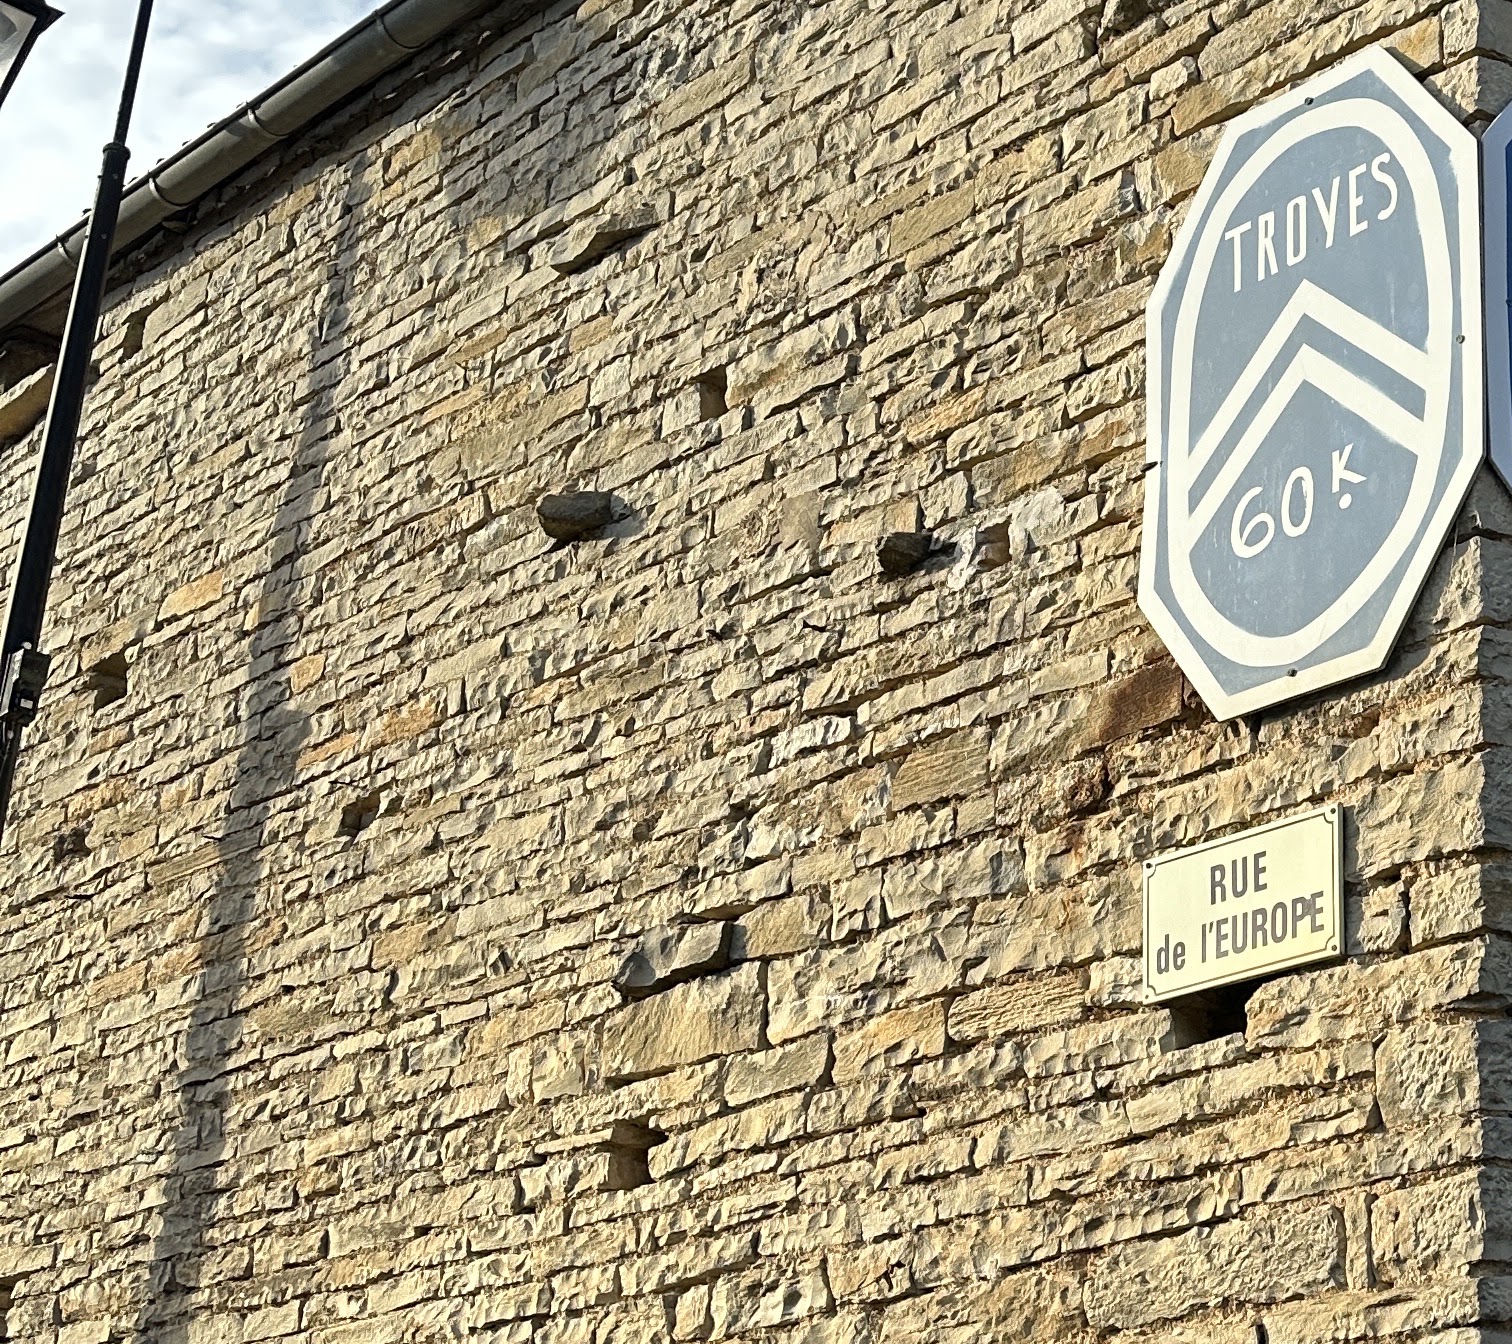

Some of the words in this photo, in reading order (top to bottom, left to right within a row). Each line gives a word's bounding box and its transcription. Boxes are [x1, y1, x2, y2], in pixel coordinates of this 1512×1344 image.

[1225, 152, 1398, 292] TROYES
[1231, 466, 1314, 558] 60
[1210, 851, 1268, 905] RUE
[1156, 934, 1186, 974] de
